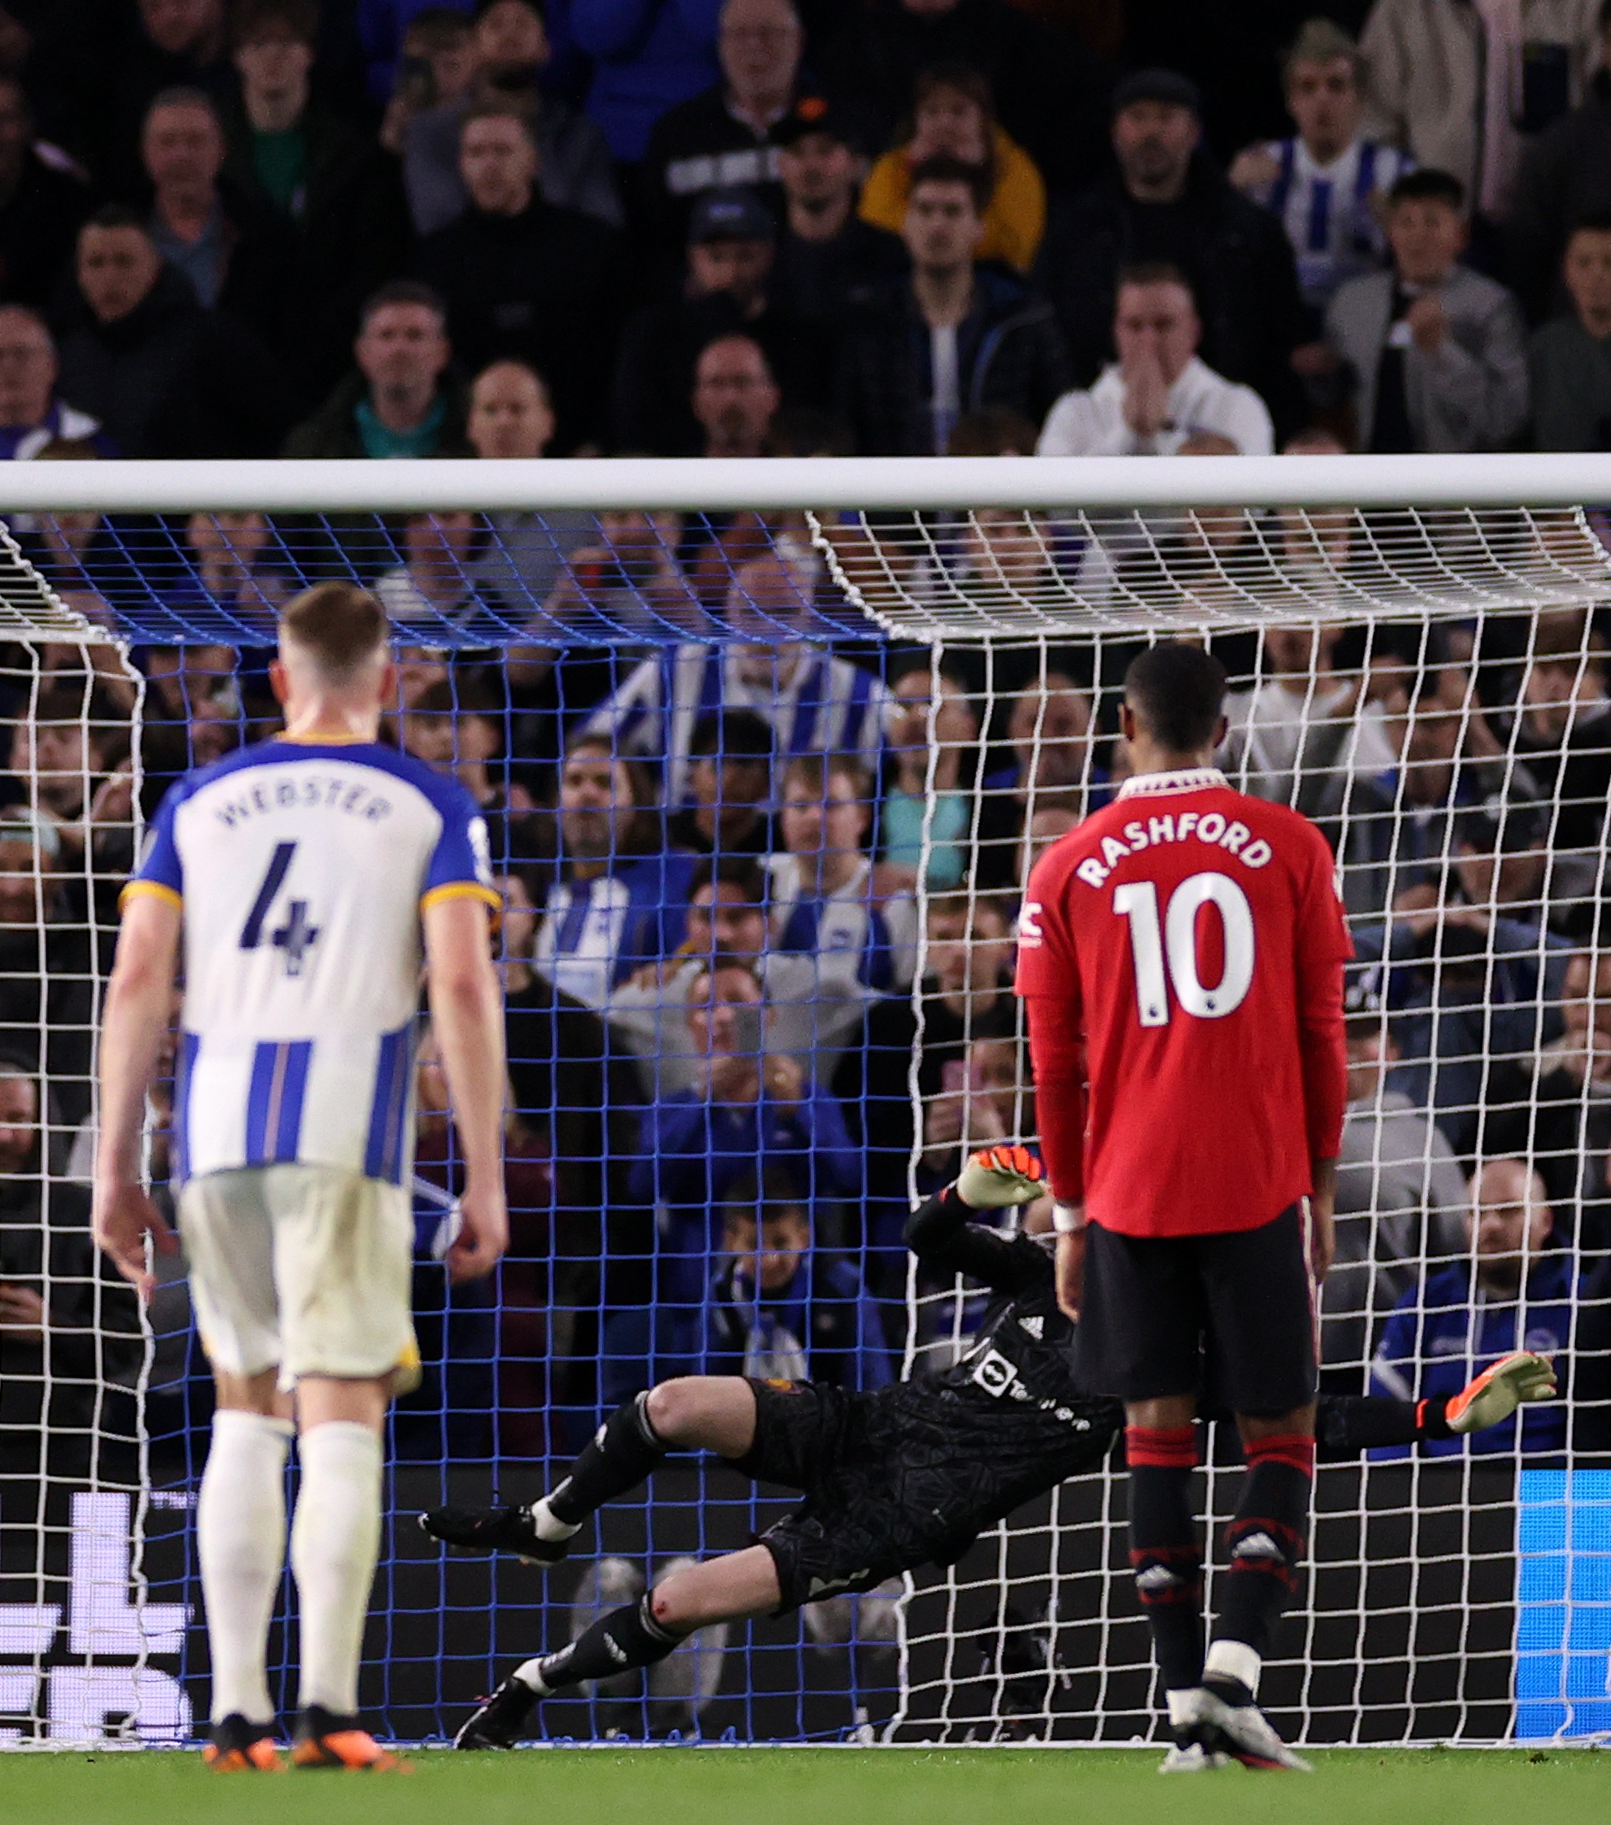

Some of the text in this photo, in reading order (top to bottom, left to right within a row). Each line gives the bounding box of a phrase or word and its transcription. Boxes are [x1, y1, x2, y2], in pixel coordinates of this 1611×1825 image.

[217, 777, 391, 829] WEBSTER
[1076, 812, 1273, 889] RASHFORD
[239, 839, 319, 976] 4
[1111, 871, 1256, 1028] 10
